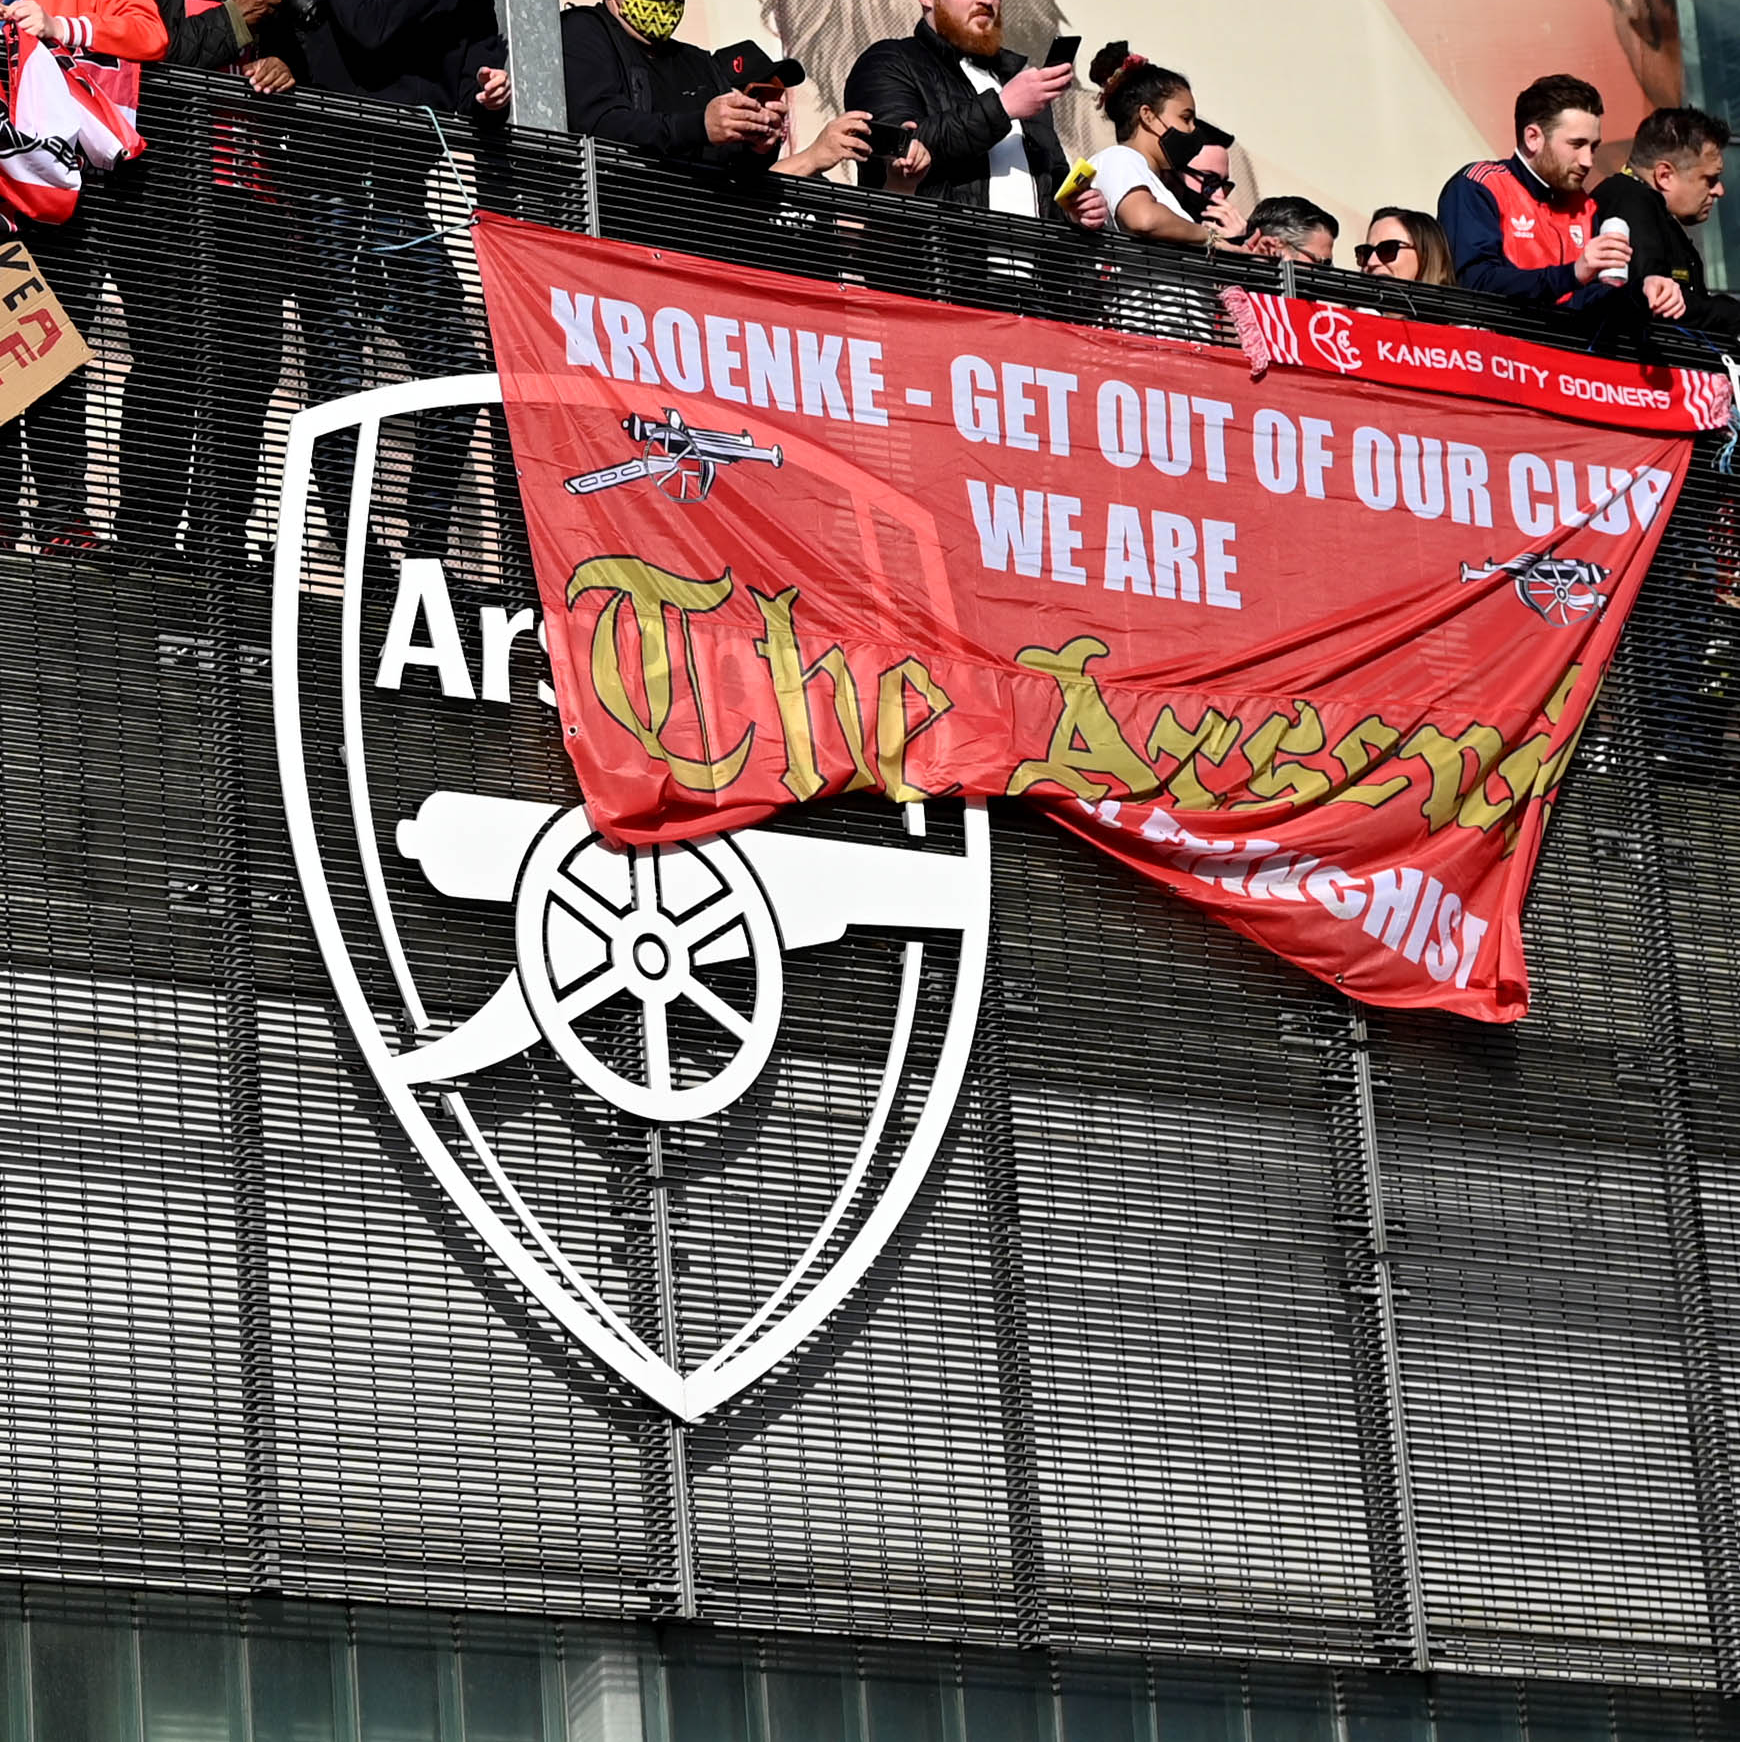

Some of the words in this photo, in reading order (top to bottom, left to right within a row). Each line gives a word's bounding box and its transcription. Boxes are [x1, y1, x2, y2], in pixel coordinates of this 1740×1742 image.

[950, 354, 1080, 456] GET
[1097, 379, 1237, 483] OUT
[1253, 407, 1335, 502] OF
[1352, 426, 1490, 536] OUR
[1376, 339, 1484, 374] KANSAS
[1491, 355, 1550, 390] CITY
[1558, 373, 1671, 411] GOONERS
[967, 479, 1086, 587] WE
[1103, 505, 1242, 611] ARE
[565, 555, 962, 804] The
